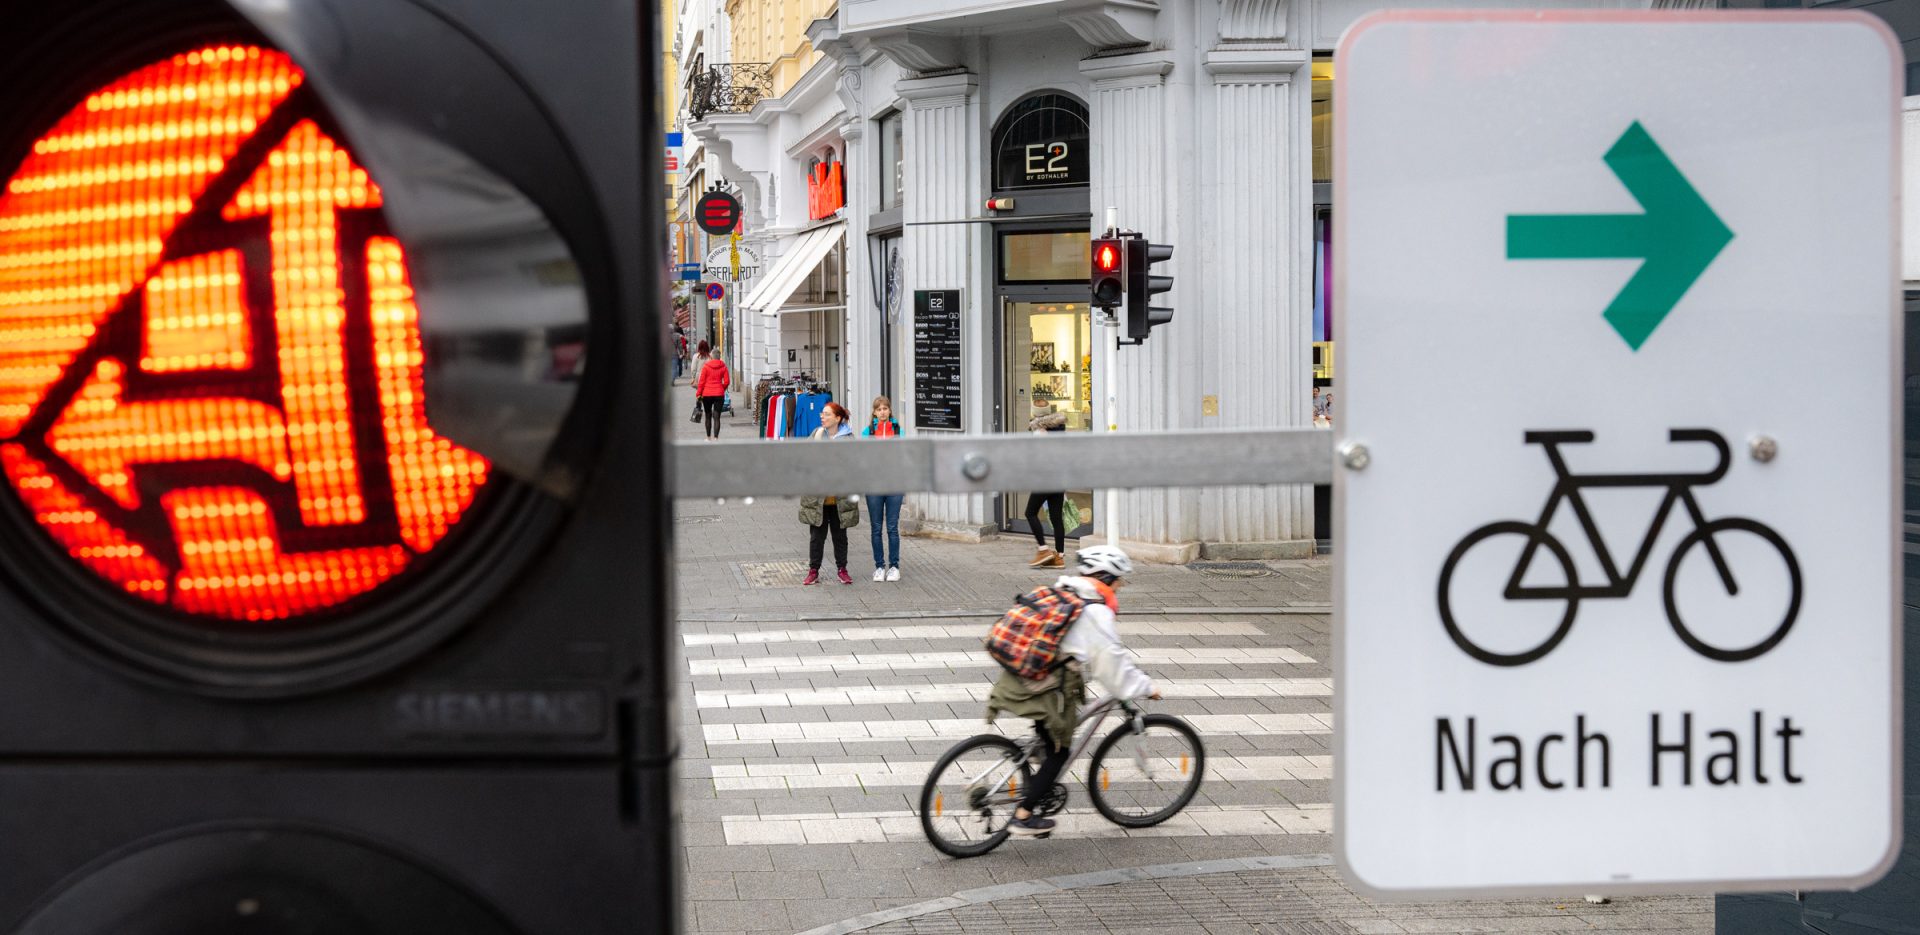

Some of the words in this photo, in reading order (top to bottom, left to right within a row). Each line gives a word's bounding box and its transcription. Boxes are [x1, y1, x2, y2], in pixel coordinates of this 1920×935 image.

[1026, 142, 1068, 173] E2
[930, 298, 942, 308] E2
[395, 692, 588, 727] SIEMENS
[1435, 713, 1611, 792] Nach
[1649, 710, 1803, 787] Halt
